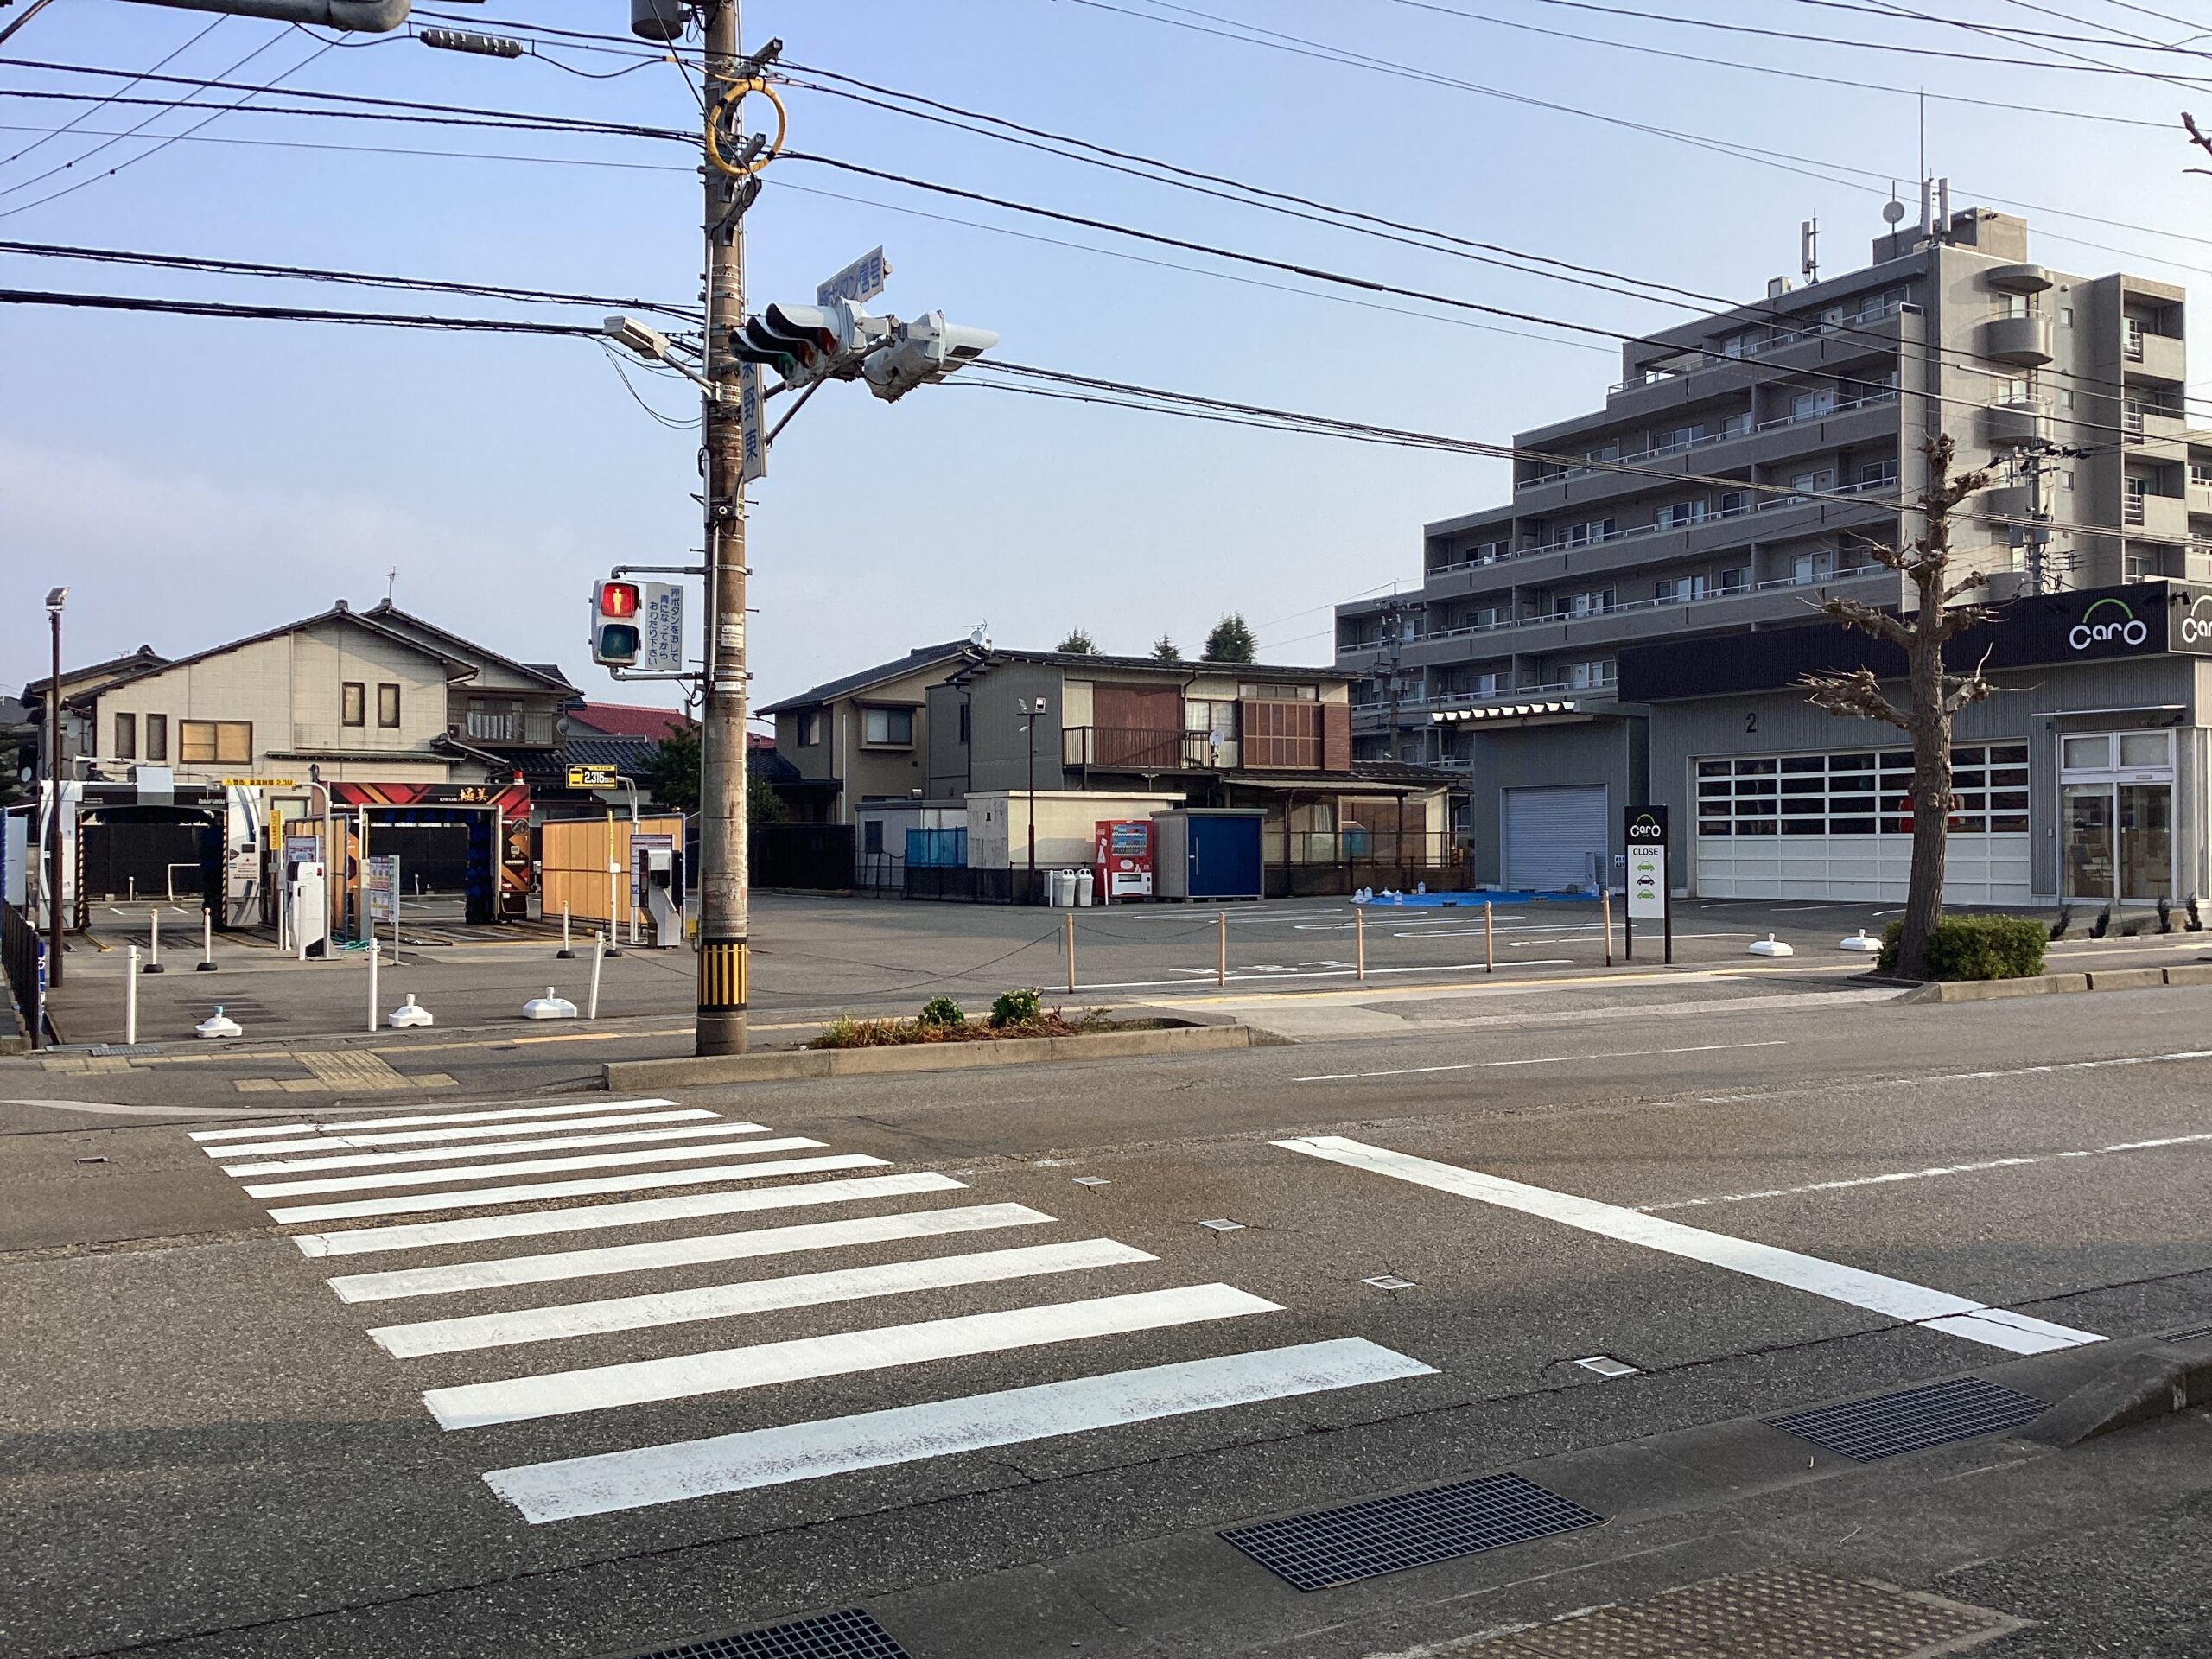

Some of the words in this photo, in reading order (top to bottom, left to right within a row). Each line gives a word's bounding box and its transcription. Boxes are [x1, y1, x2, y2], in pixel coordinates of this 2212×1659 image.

[648, 601, 658, 665] おわたり下さい
[659, 594, 670, 660] 青になってから
[671, 588, 679, 662] 押ボタンをおして
[1745, 712, 1757, 733] 2
